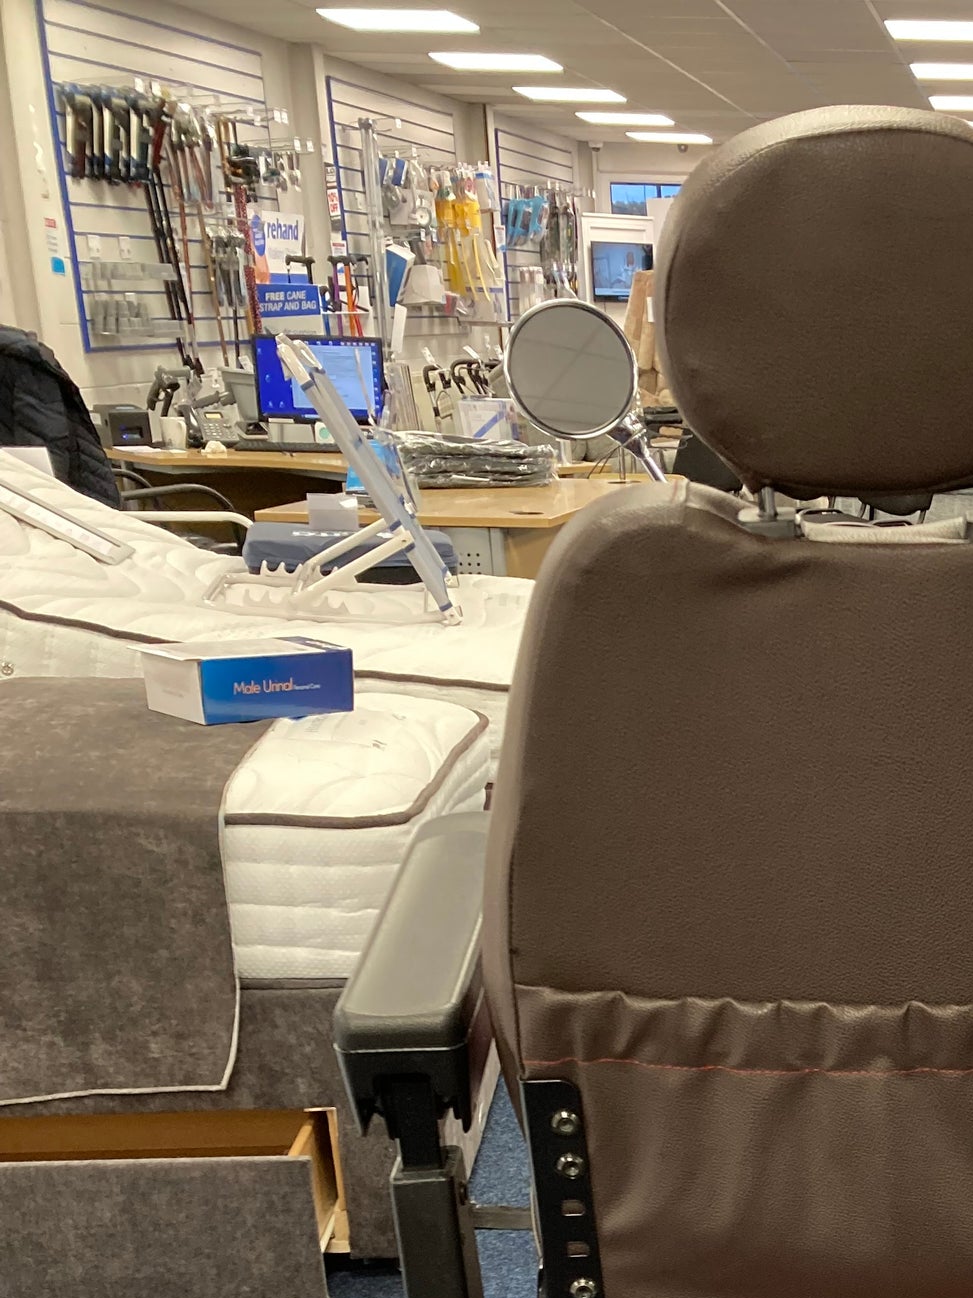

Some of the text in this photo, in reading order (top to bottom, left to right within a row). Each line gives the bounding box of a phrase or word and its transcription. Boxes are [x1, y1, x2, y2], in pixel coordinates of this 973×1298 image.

[267, 218, 299, 241] rehand
[265, 290, 306, 301] FREE CANE
[259, 300, 317, 312] STRAP AND BAG
[233, 680, 261, 695] Male
[262, 677, 293, 693] Urinal
